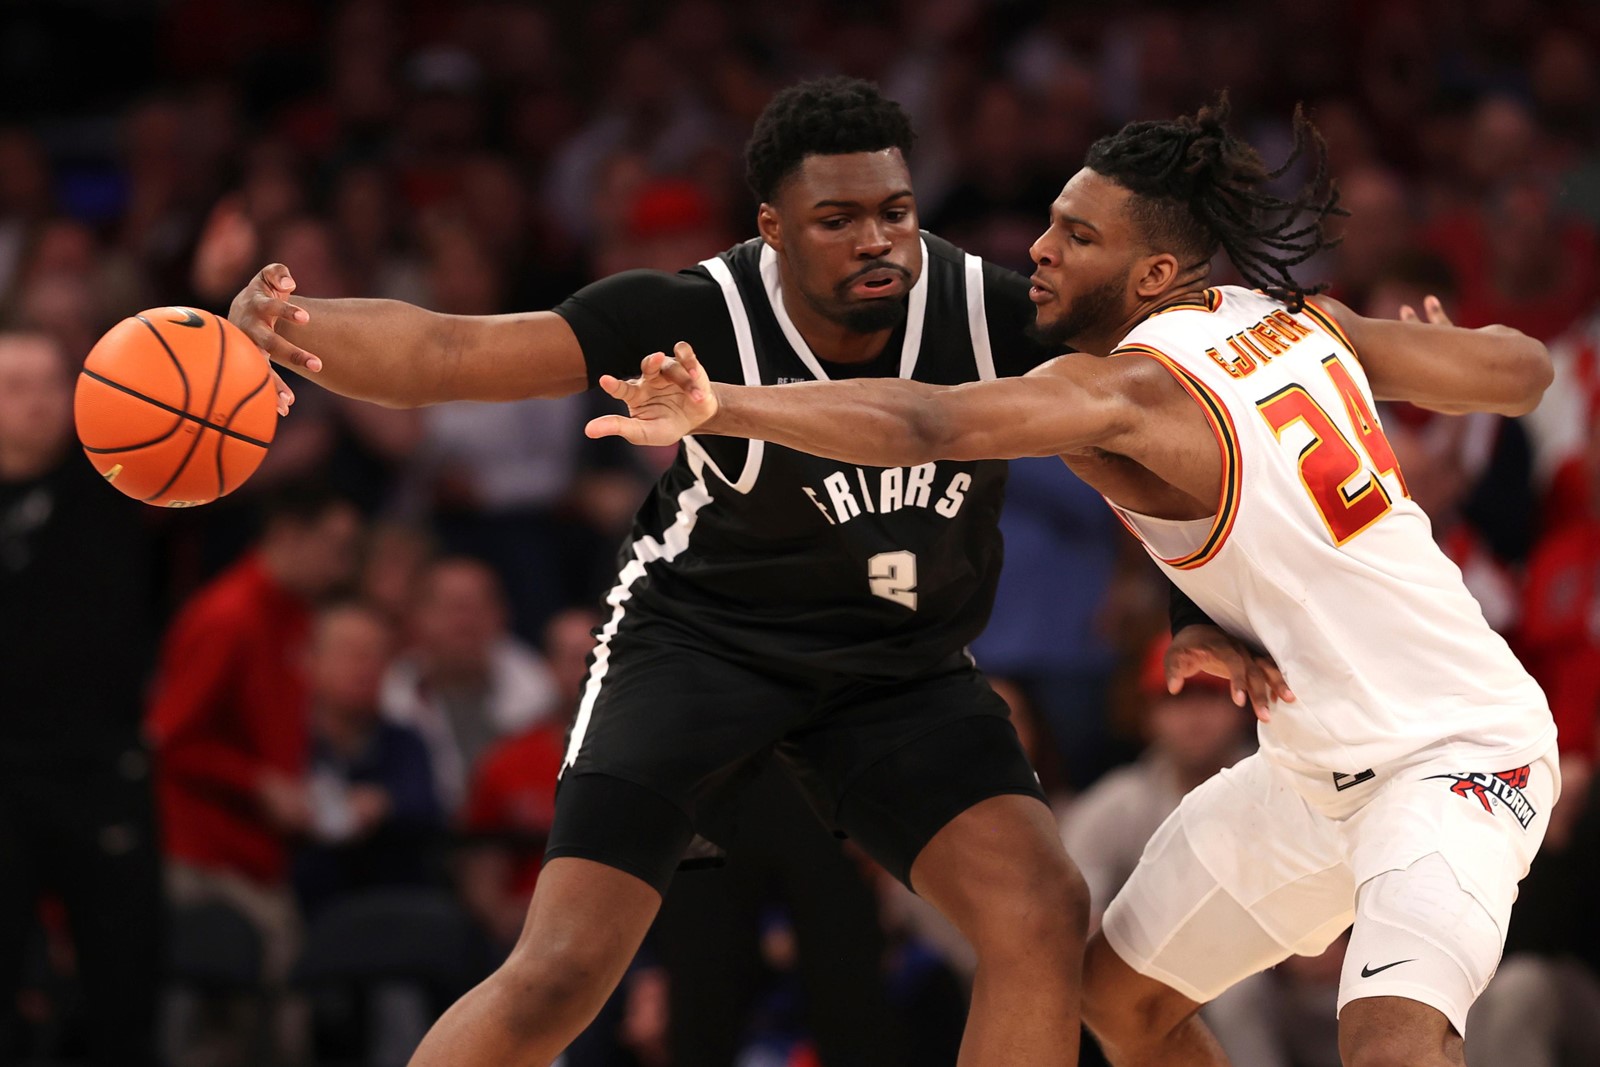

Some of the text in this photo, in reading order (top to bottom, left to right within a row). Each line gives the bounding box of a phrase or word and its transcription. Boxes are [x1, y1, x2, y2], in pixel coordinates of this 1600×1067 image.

[1205, 308, 1314, 379] EJIOFOR
[1255, 352, 1411, 547] 24
[802, 461, 972, 525] FRIARS
[867, 549, 918, 612] 2
